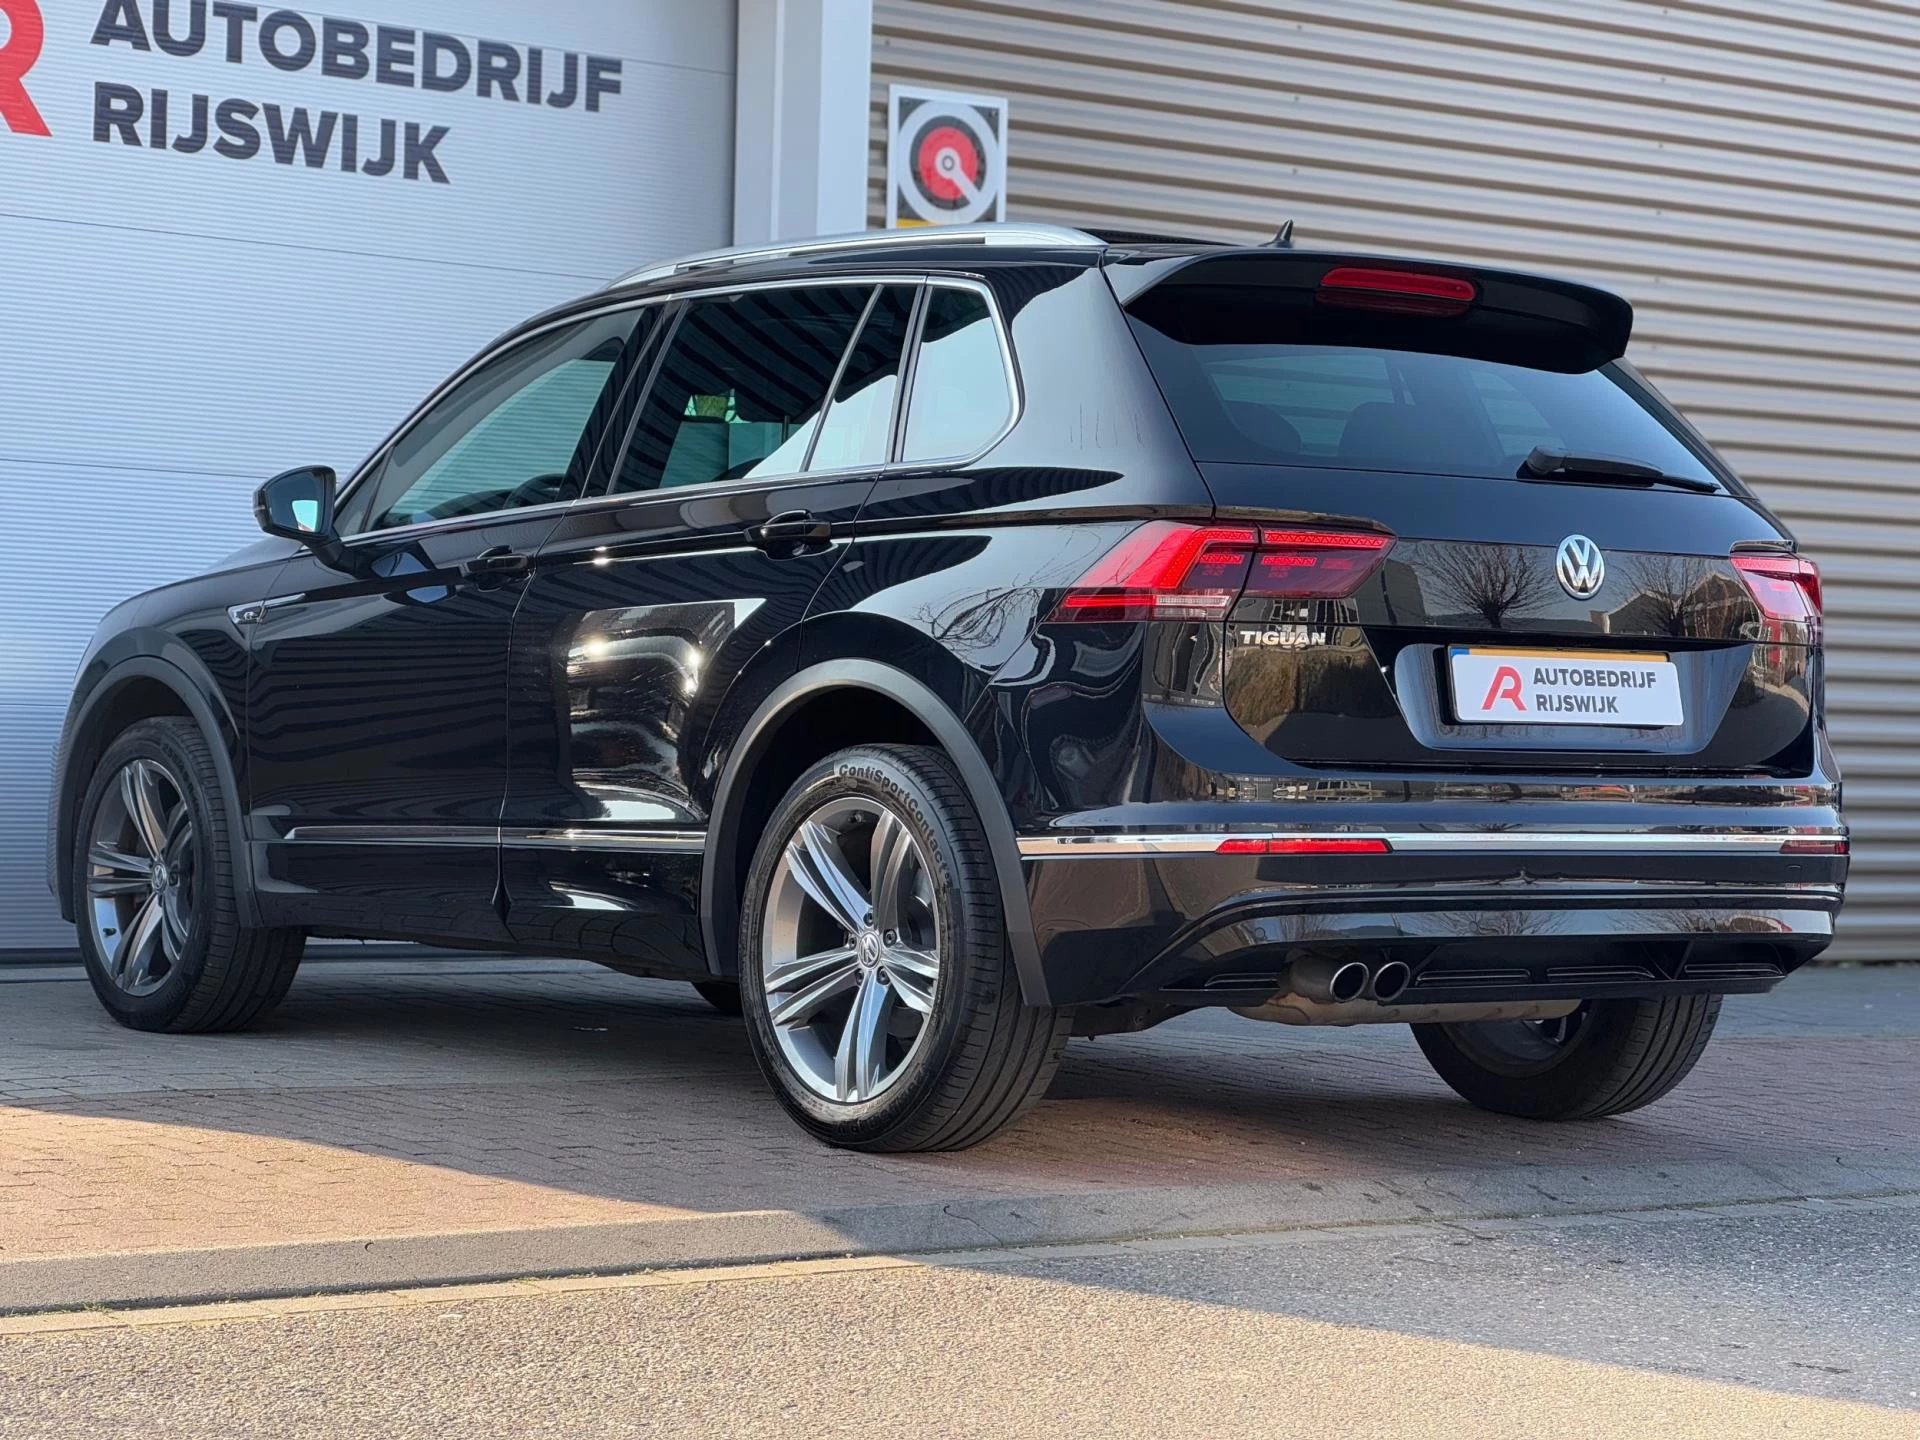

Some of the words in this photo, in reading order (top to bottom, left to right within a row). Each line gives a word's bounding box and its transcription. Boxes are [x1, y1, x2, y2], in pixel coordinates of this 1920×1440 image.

[90, 0, 623, 113] AUTOBEDRIJF
[93, 81, 451, 185] RIJSWIJK
[1240, 630, 1326, 645] TIGUAN
[1533, 667, 1657, 689] AUTOBEDRIJF
[1535, 693, 1619, 713] RIJSWIJK
